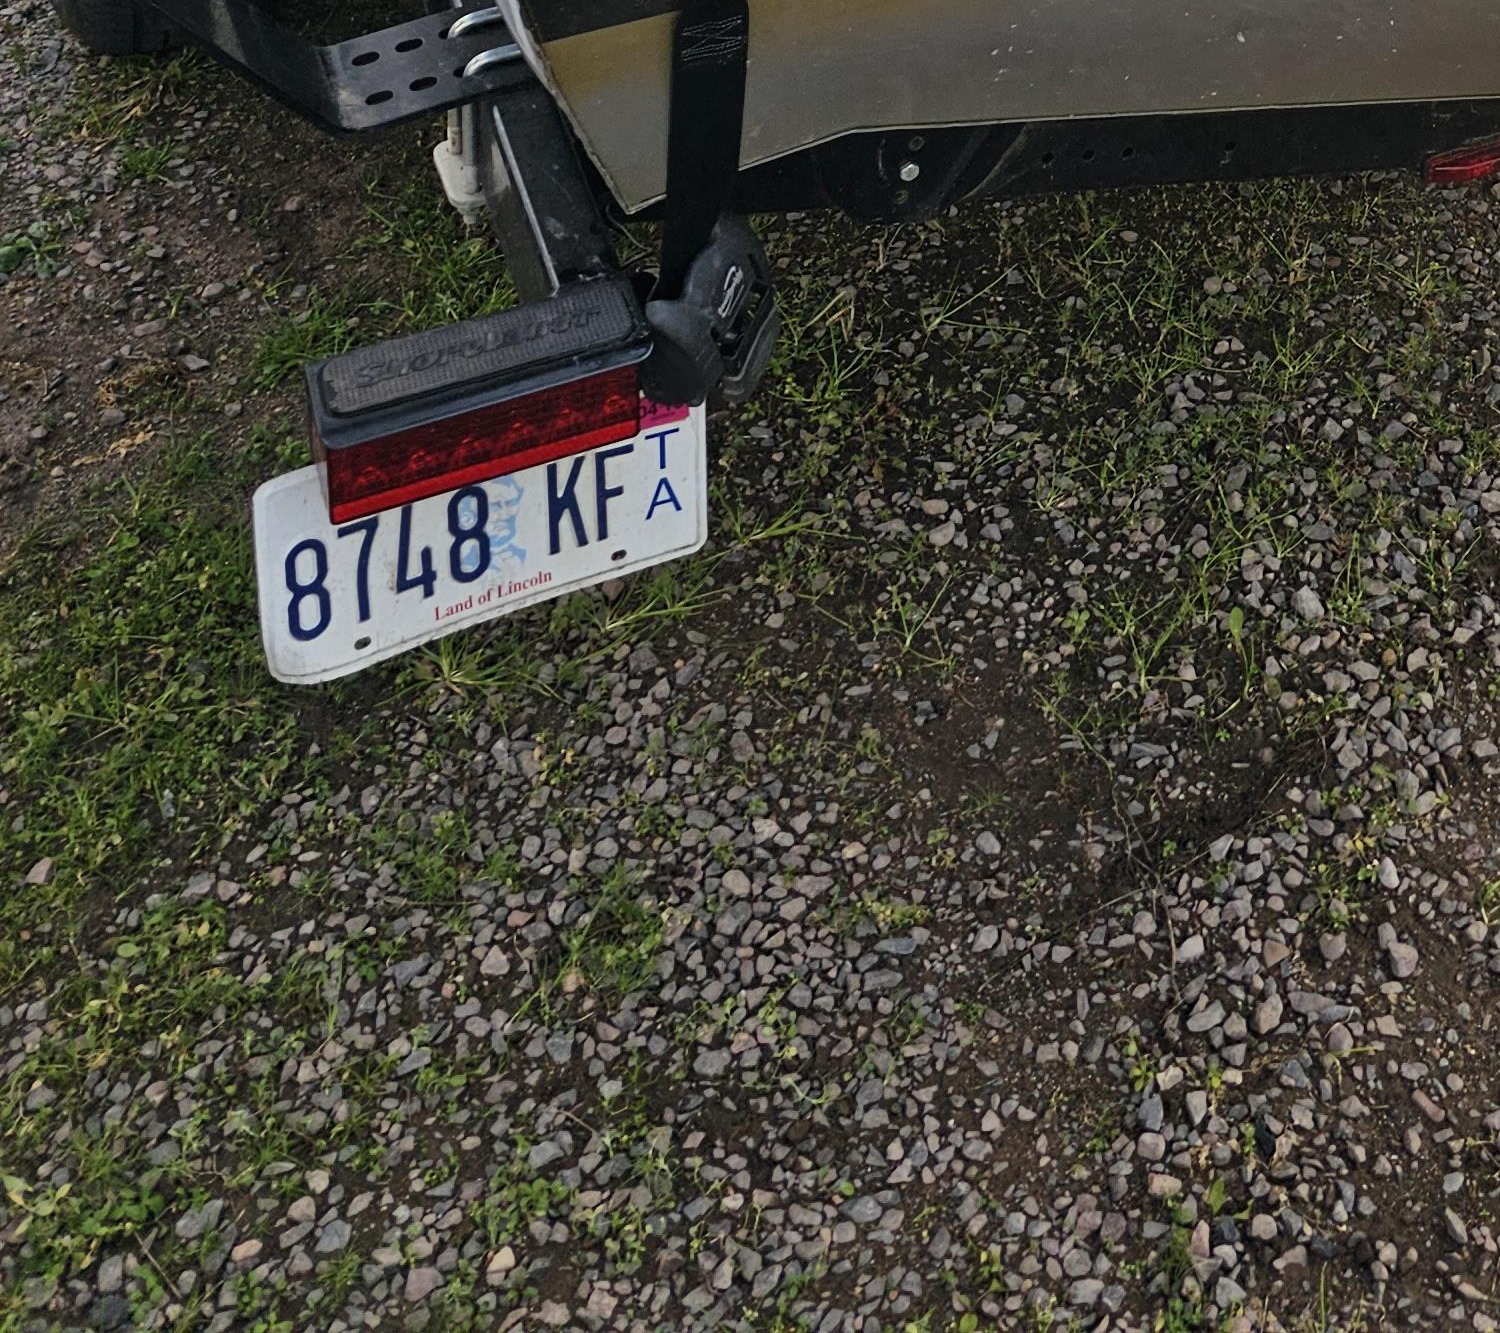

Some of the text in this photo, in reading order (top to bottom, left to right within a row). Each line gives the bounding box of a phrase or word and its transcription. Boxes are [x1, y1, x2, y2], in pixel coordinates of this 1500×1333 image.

[284, 444, 635, 641] 8748 KF
[434, 570, 554, 621] Land of Lincoln
